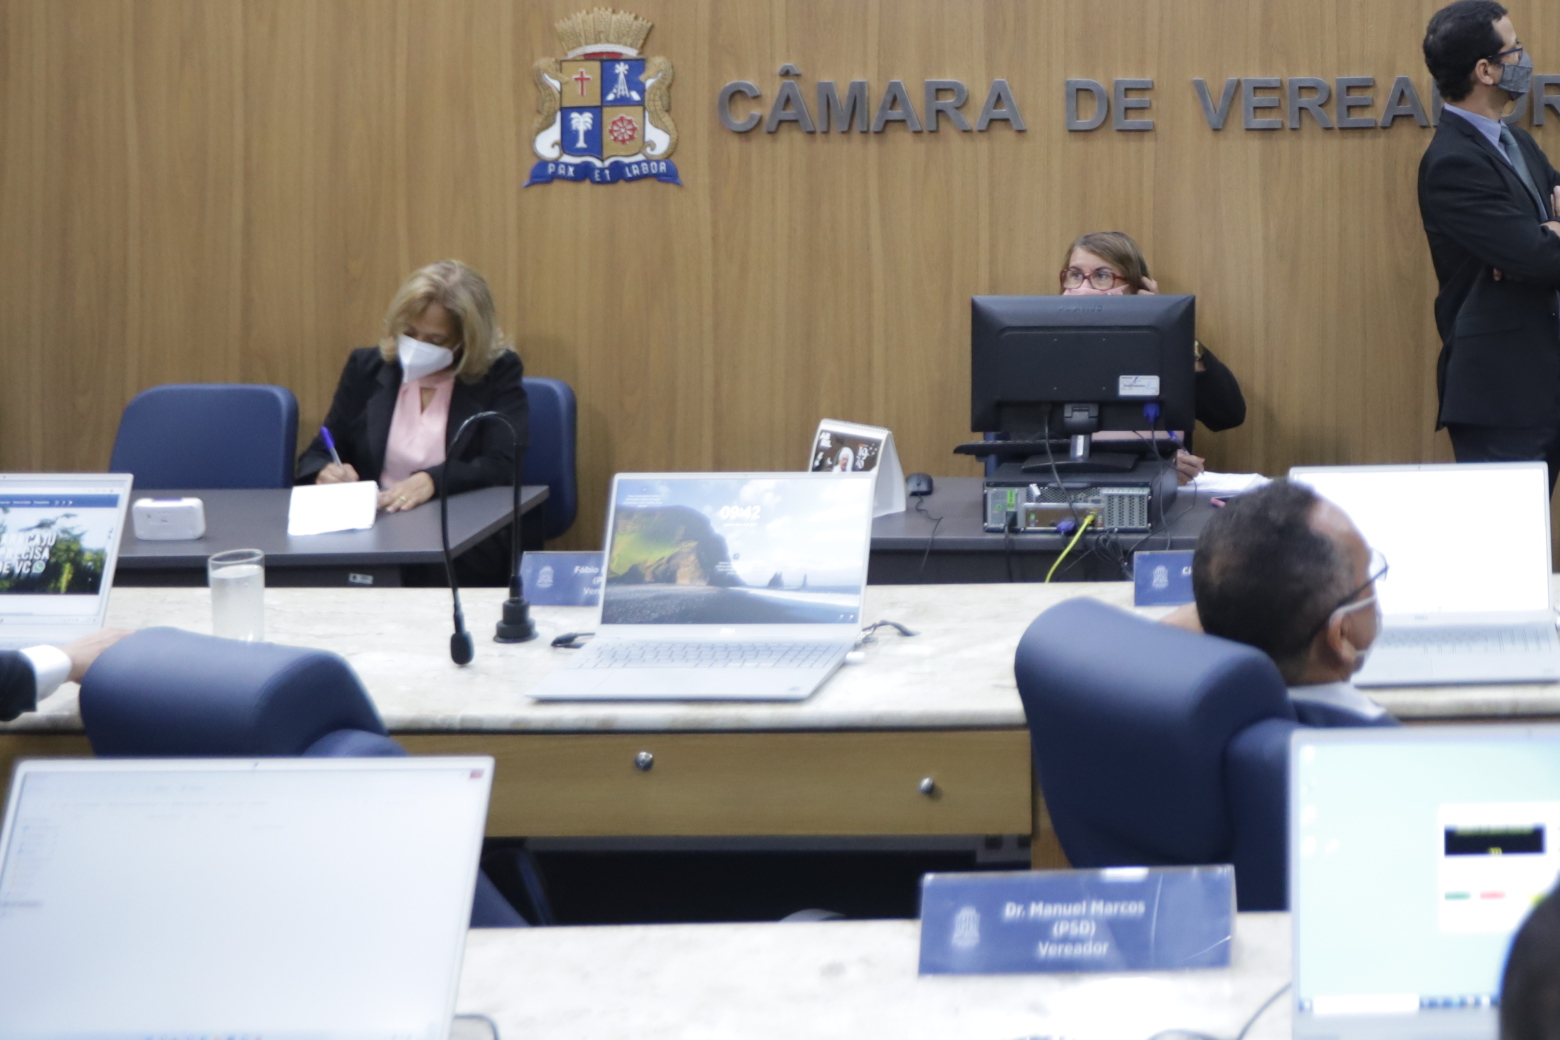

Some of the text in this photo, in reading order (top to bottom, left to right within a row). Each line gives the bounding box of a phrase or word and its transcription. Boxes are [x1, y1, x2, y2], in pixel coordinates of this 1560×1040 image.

[716, 64, 1027, 134] CÂMARA
[1064, 77, 1155, 132] DE
[547, 161, 667, 182] PAX ET LABOR
[720, 505, 762, 520] 09:42
[1004, 898, 1147, 920] Dr. Manuel Marcos
[1052, 919, 1097, 938] (PSD)
[1036, 939, 1110, 959] Vereador
